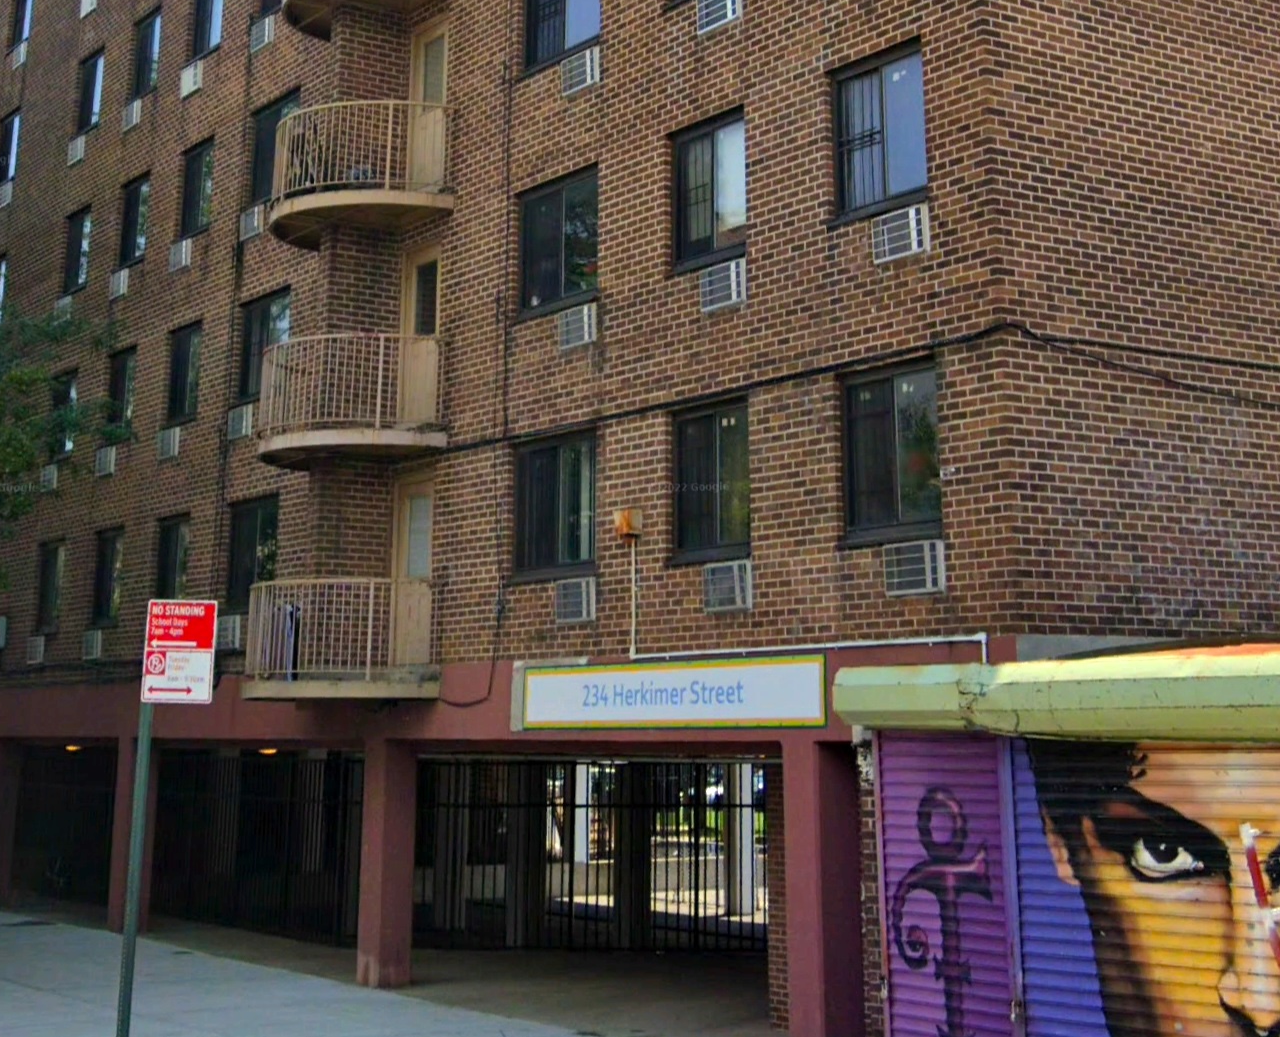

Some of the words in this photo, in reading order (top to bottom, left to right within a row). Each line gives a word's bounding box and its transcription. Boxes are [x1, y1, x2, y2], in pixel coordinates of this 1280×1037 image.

[152, 605, 163, 615] NO
[165, 605, 205, 616] STANDING
[152, 617, 172, 626] School
[173, 617, 188, 627] Days
[582, 684, 608, 707] 234
[613, 681, 686, 706] Herkimer
[690, 680, 744, 705] Street
